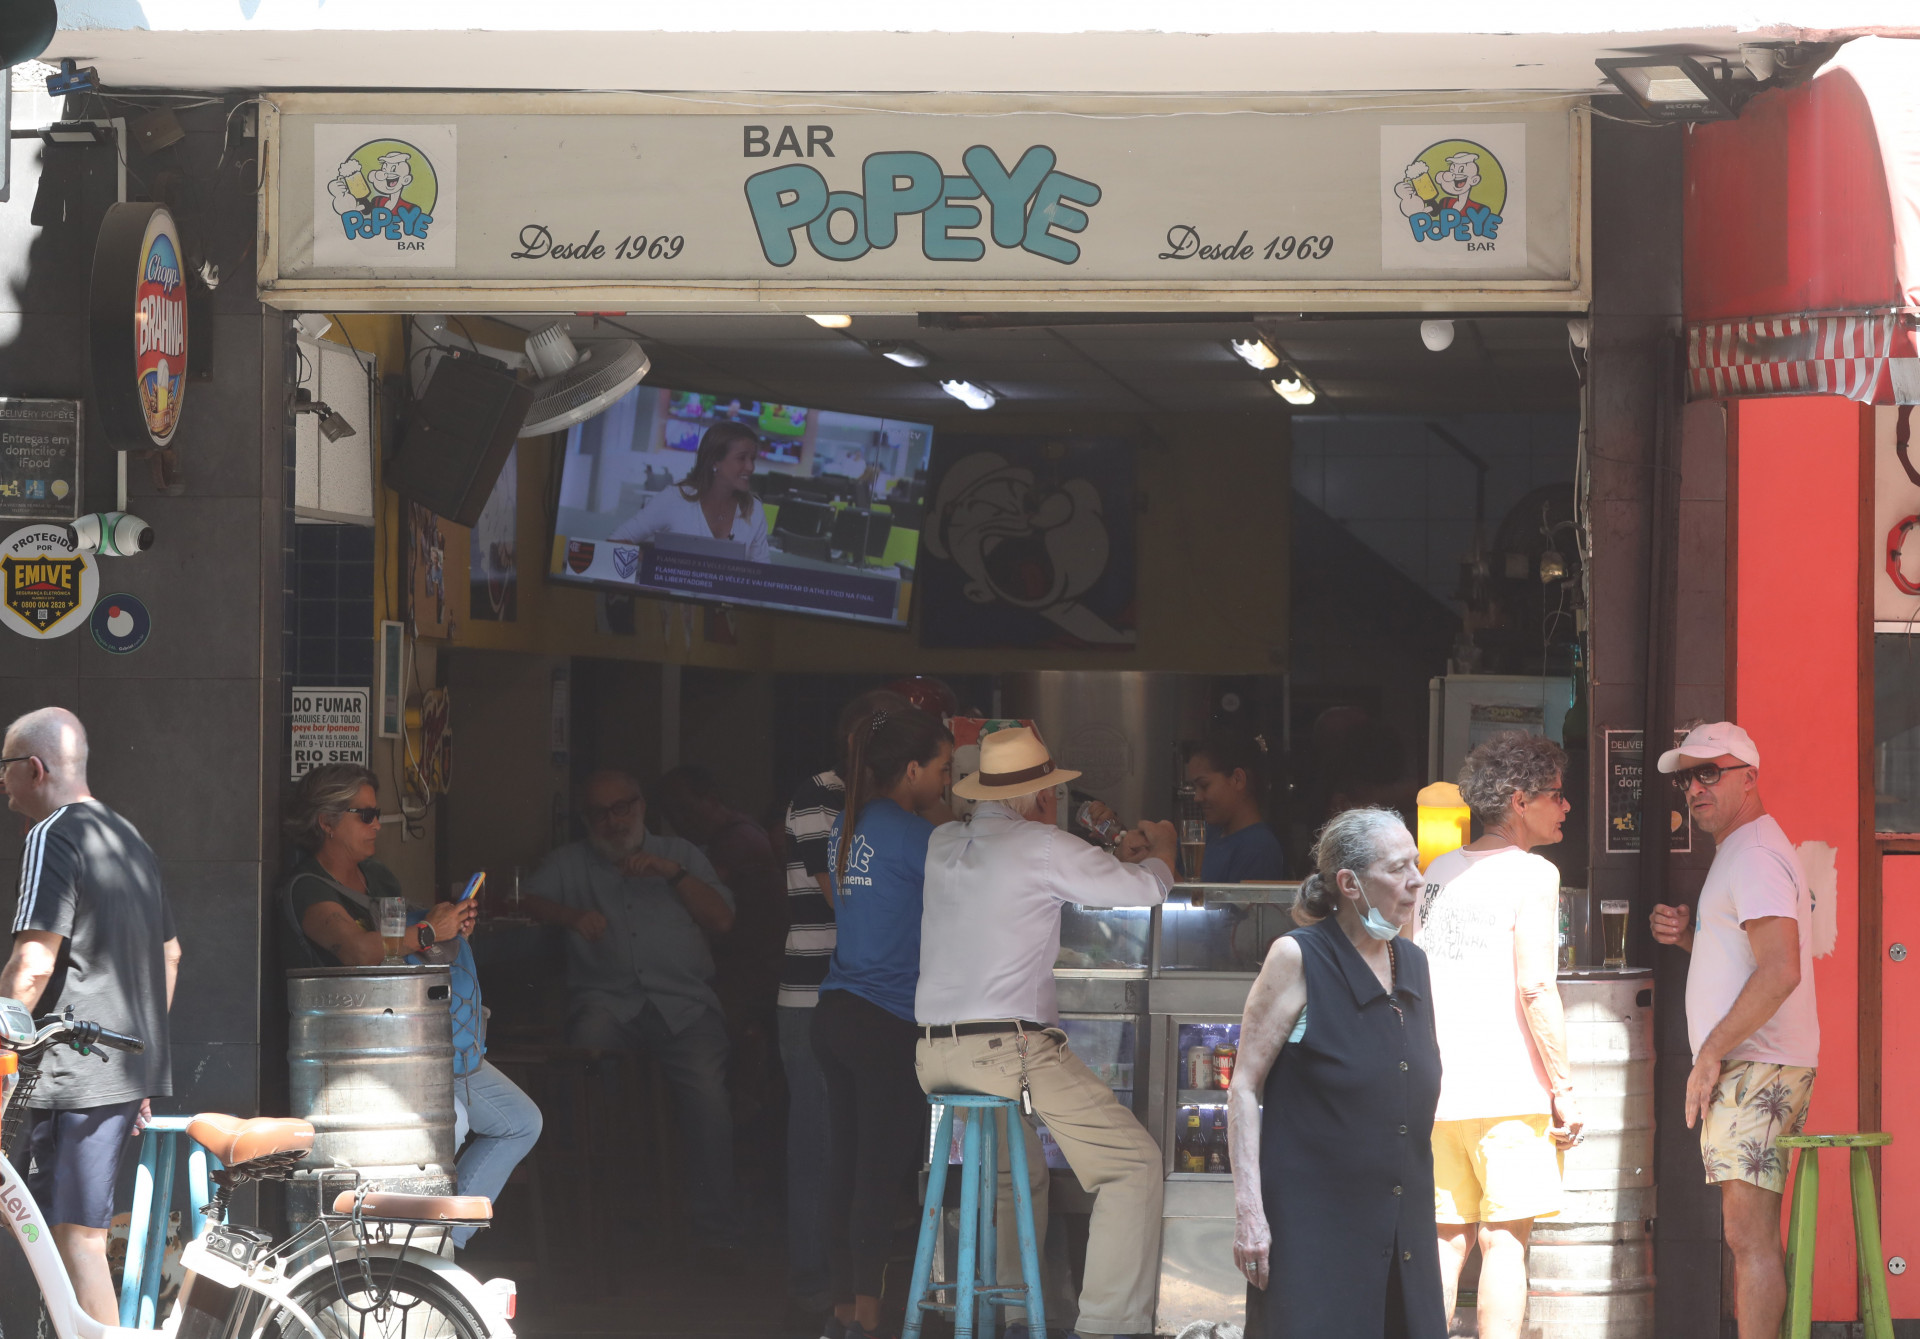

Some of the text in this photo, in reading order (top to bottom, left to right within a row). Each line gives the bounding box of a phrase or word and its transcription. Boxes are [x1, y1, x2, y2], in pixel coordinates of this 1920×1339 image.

[743, 125, 836, 158] BAR
[744, 144, 1102, 267] POPEYE
[341, 206, 434, 240] POPEYE
[1408, 207, 1503, 242] POPEYE
[397, 241, 425, 251] BAR
[511, 224, 685, 260] Desde 1969
[1158, 224, 1334, 260] Desde 1969
[1467, 242, 1496, 251] BAR
[147, 253, 180, 293] Chopp
[140, 295, 184, 356] BRAHMA
[0, 409, 75, 419] DELIVERY POPEYE
[2, 433, 70, 447] Entregas em
[12, 532, 75, 552] PROTEGIDO
[15, 564, 72, 589] EMIVE
[654, 573, 713, 589] DA LIBERTADORES
[655, 565, 691, 577] FLAMENGO
[692, 570, 718, 581] SUPERA
[763, 580, 801, 592] ENFRENTAR
[37, 601, 49, 609] 004
[293, 697, 362, 713] DO FUMAR
[312, 723, 325, 732] bar
[326, 724, 360, 733] Ipanema
[335, 740, 363, 749] FEDERAL
[1611, 740, 1644, 749] DELIVE
[295, 750, 363, 762] RIO SEM
[0, 1184, 32, 1222] Lev
